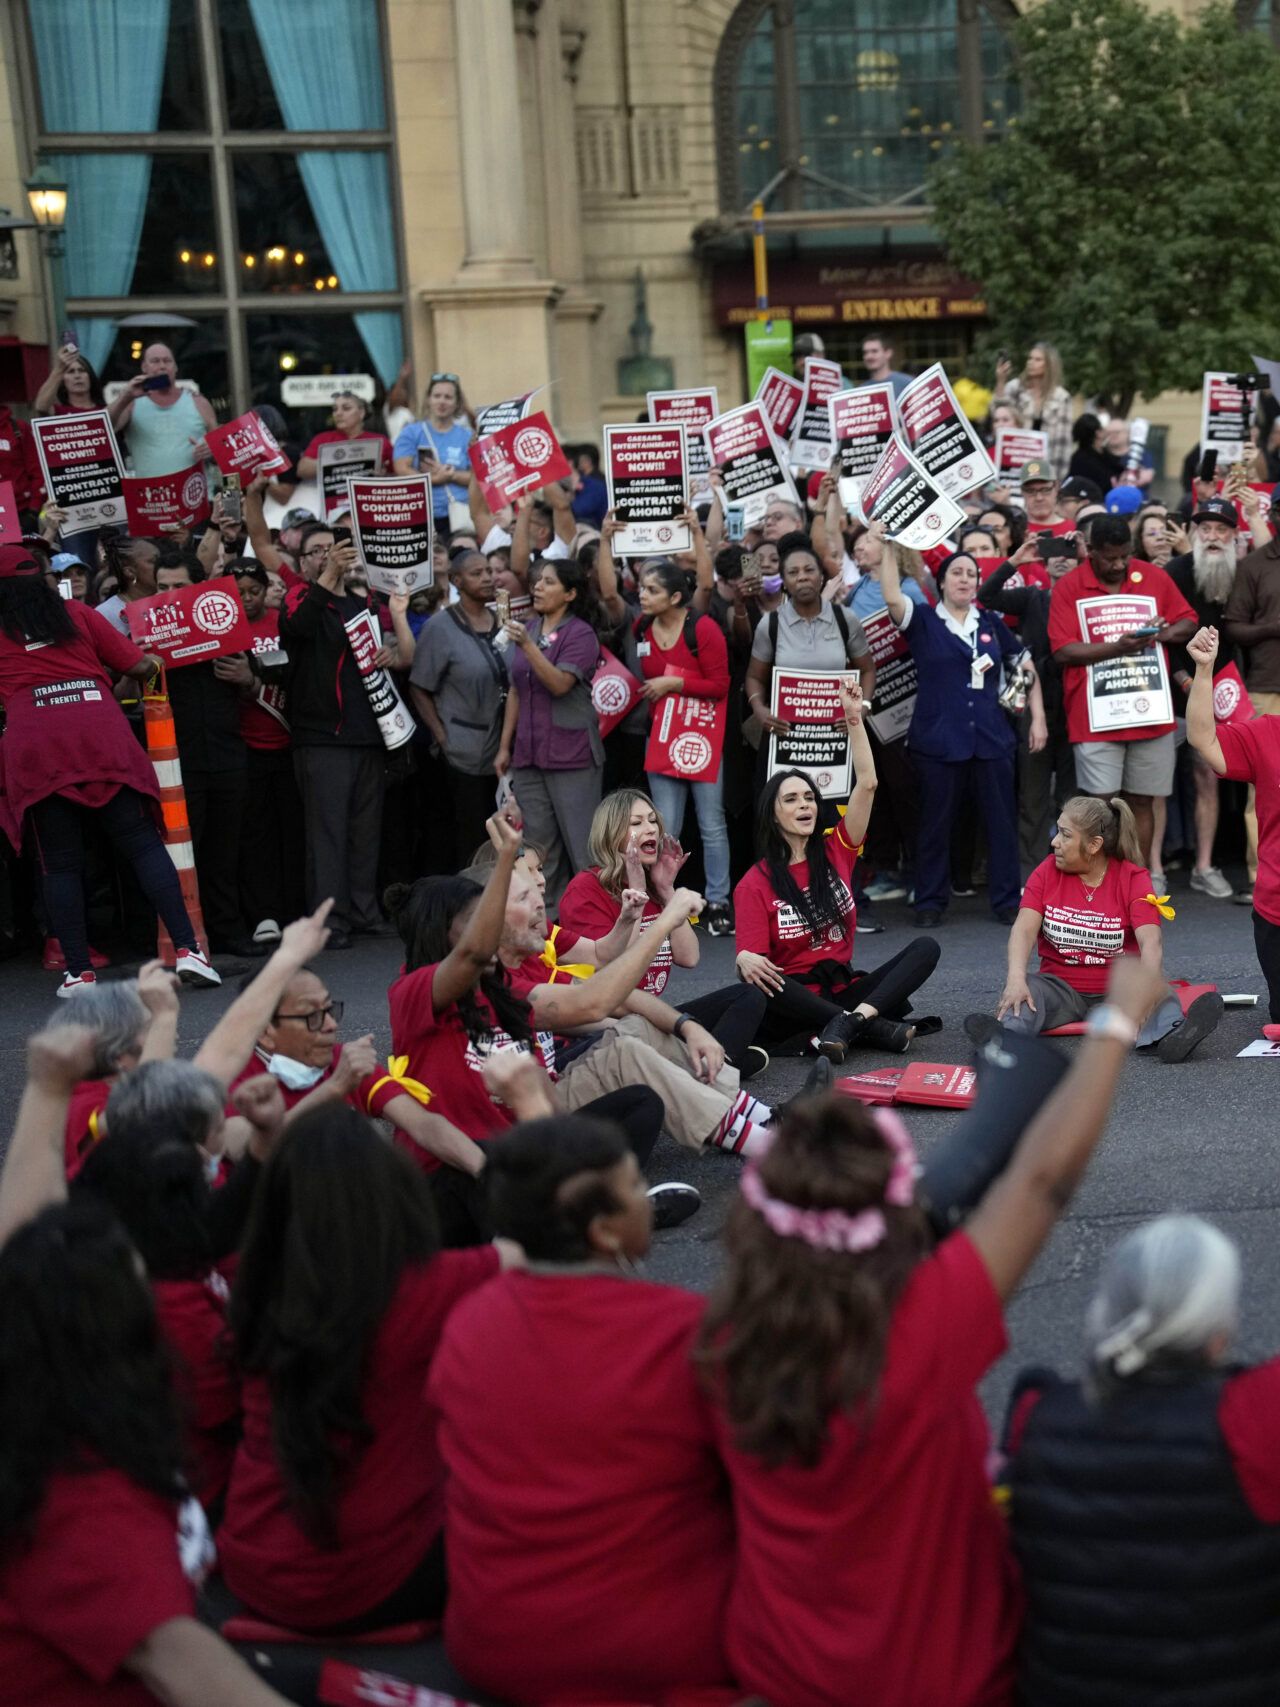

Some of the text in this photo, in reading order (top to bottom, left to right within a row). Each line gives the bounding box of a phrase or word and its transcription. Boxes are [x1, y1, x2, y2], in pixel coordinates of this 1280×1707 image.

[842, 297, 940, 321] ENTRANCE
[906, 393, 946, 427] CONTRACT
[837, 412, 887, 428] CONTRACT
[55, 424, 88, 433] CAESARS
[42, 428, 105, 442] ENTERTAINMENT:
[48, 437, 106, 452] CONTRACT
[613, 441, 678, 450] ENTERTAINMENT:
[714, 428, 763, 454] CONTRACT
[60, 448, 96, 461] NOW!!!
[617, 451, 679, 462] CONTRACT
[928, 445, 963, 471] AHORA!
[64, 463, 99, 473] CAESARS
[628, 462, 665, 471] NOW!!!
[52, 466, 116, 482] ENTERTAINMENT:
[55, 476, 119, 495] ¡CONTRATO
[615, 485, 681, 494] ENTERTAINMENT:
[68, 488, 111, 502] AHORA!
[357, 493, 423, 501] ENTERTAINMENT:
[362, 501, 424, 512] CONTRACT
[628, 507, 671, 517] AHORA!
[374, 513, 411, 522] NOW!!!
[890, 496, 925, 532] AHORA!
[362, 532, 426, 542] ENTERTAINMENT:
[376, 528, 412, 536] CAESARS
[365, 541, 427, 554] ¡CONTRATO
[376, 553, 418, 563] AHORA!
[1101, 606, 1136, 615] CAESARS
[151, 622, 178, 633] CULINARY
[144, 626, 191, 644] WORKERS UNION
[1094, 666, 1158, 681] ¡CONTRATO
[34, 681, 96, 697] ¡TRABAJADORES
[797, 681, 834, 689] CAESARS
[1105, 677, 1149, 690] AHORA!
[50, 694, 80, 705] FRENTE!
[784, 696, 841, 707] CONTRAC
[795, 708, 833, 717] NOW!!!
[779, 741, 845, 751] ¡CONTRATO
[789, 752, 834, 762] AHORA!
[1069, 918, 1101, 927] CONTRACT
[1073, 914, 1103, 922] ARRESTED
[1051, 923, 1061, 932] JOB
[1062, 927, 1086, 937] SHOULD
